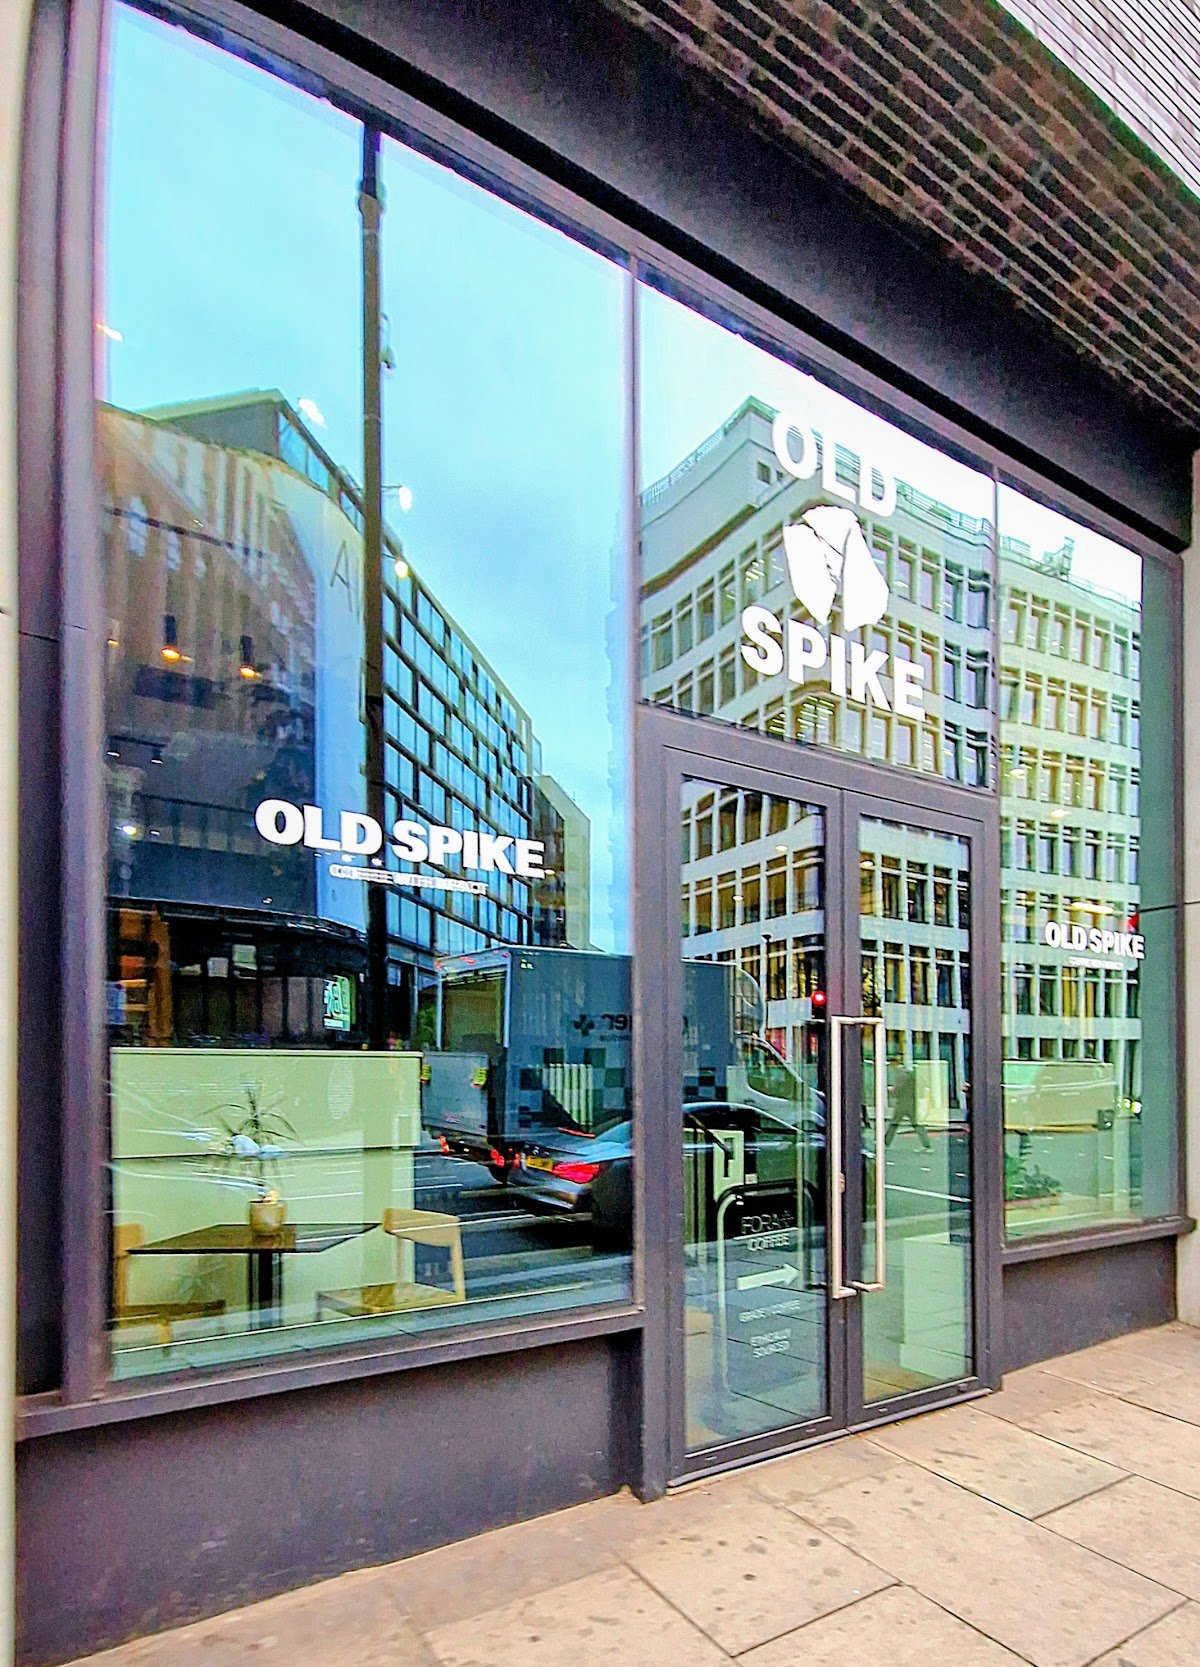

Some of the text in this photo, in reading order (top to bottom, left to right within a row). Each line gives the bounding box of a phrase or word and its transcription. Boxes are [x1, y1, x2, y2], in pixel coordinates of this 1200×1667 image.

[772, 411, 897, 517] OLD
[741, 605, 925, 722] SPIKE
[255, 799, 545, 879] OLD SPIKE
[1045, 921, 1145, 959] OLD SPIKE
